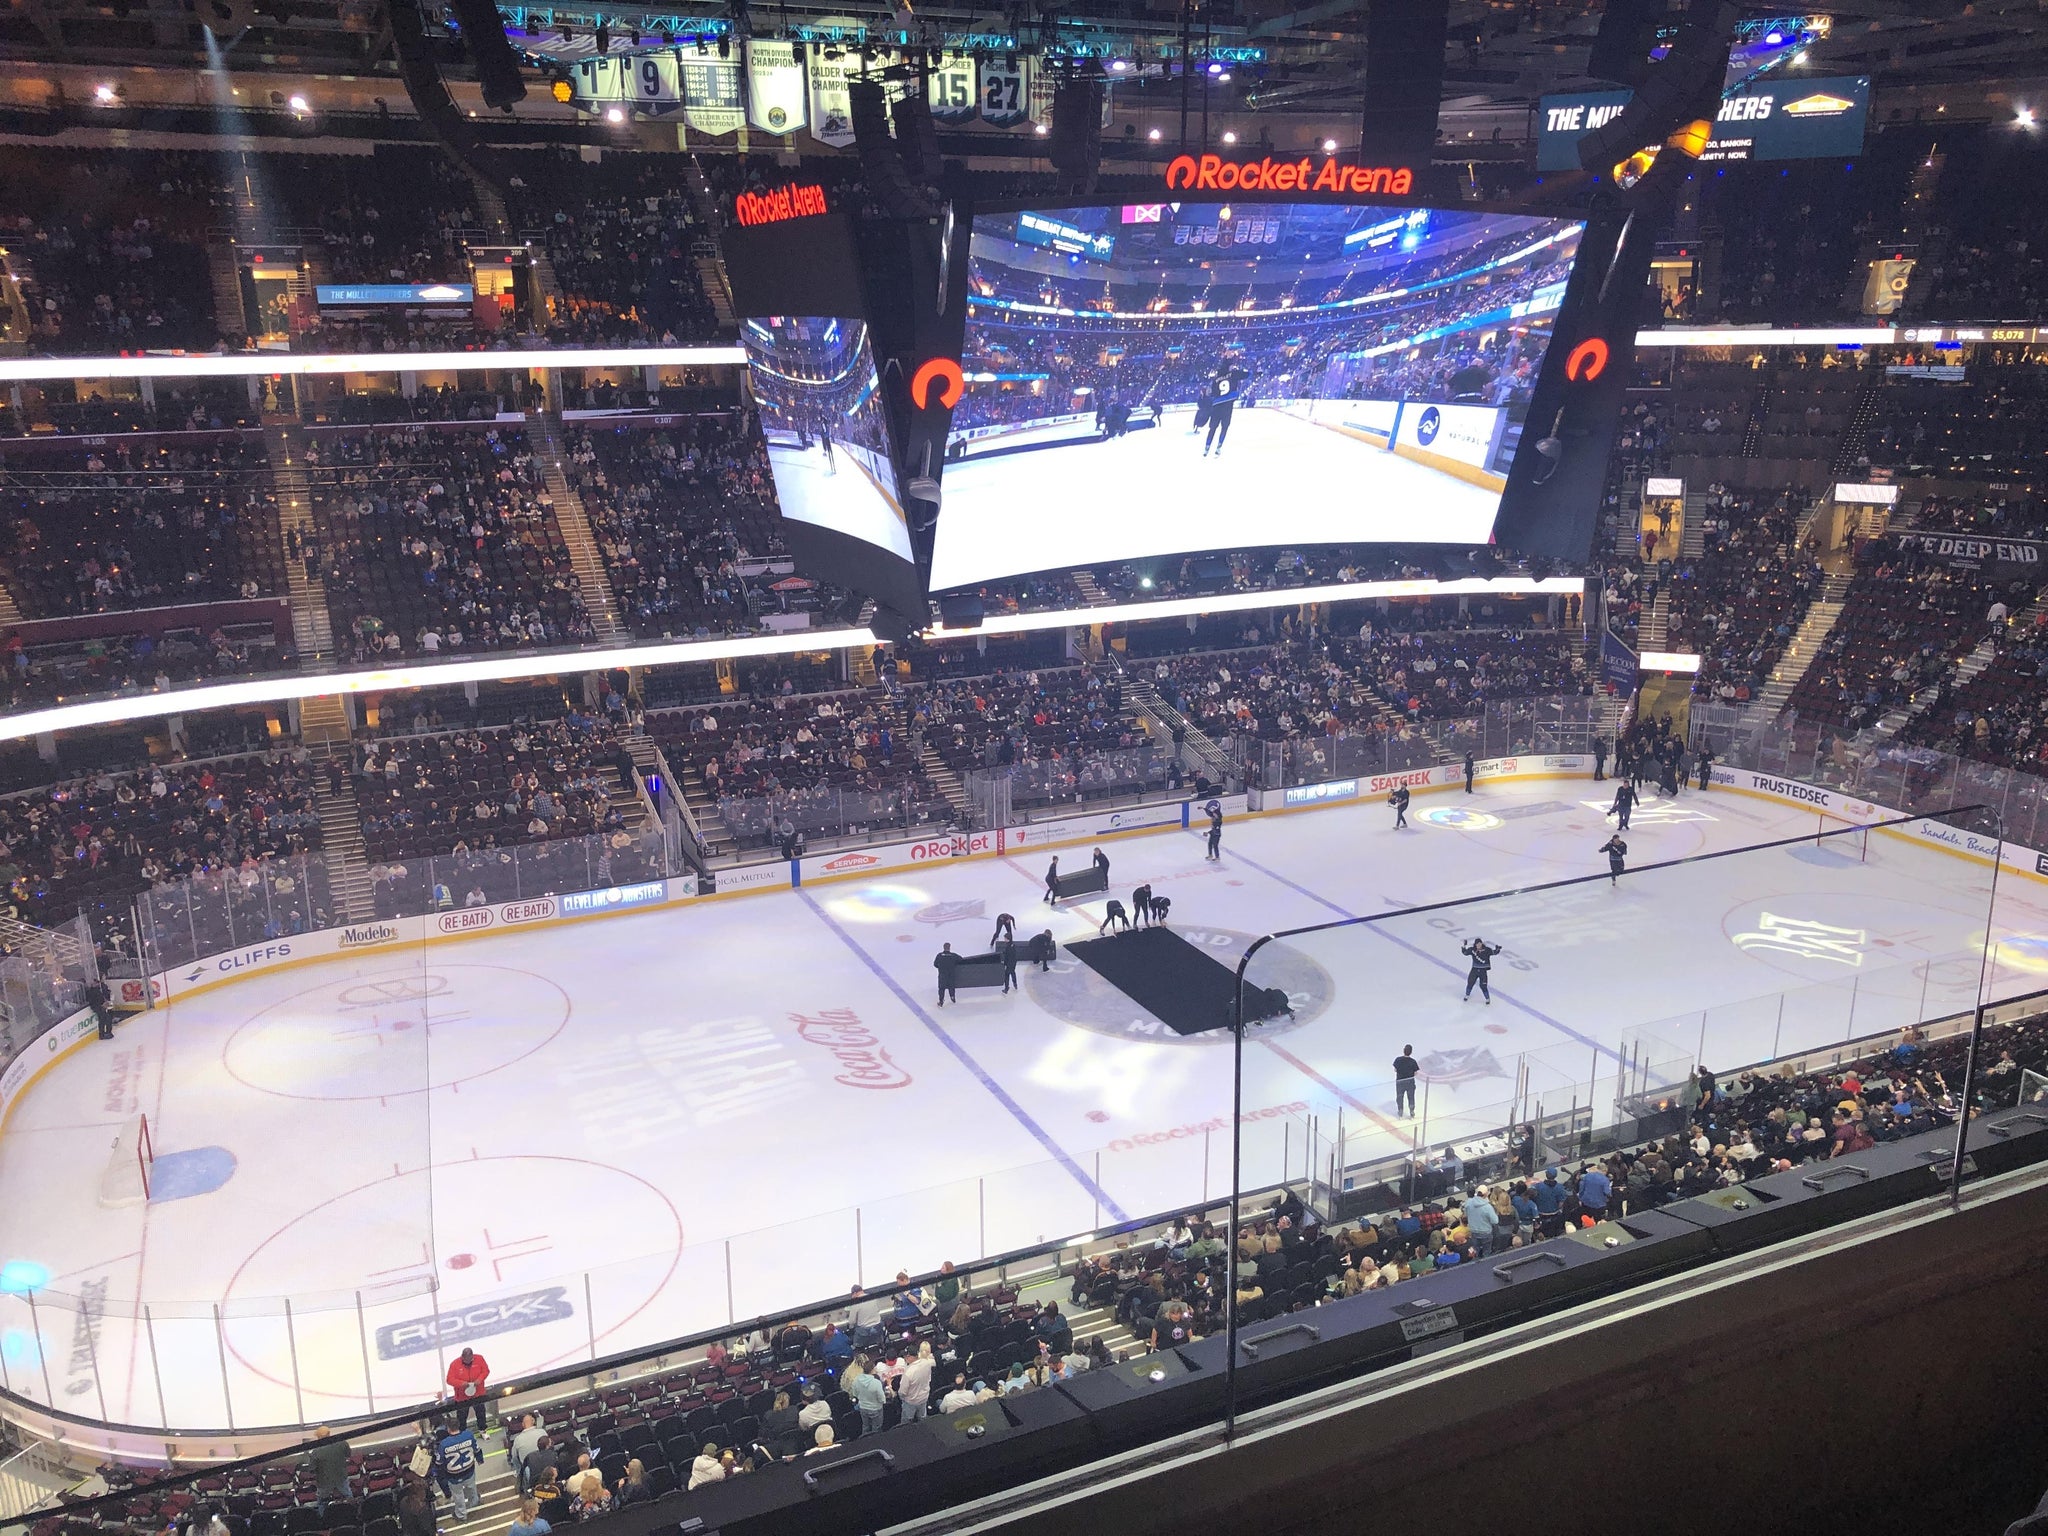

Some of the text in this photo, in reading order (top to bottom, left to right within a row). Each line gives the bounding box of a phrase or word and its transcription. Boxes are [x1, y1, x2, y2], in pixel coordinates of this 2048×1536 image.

[772, 50, 792, 58] DIVISIO
[642, 61, 660, 96] 9
[810, 66, 840, 78] CALDER
[937, 73, 968, 106] 15
[987, 76, 1020, 110] 27
[1547, 107, 1582, 131] THE
[1720, 139, 1752, 148] BANKING
[1728, 152, 1747, 160] NOW,
[1196, 154, 1413, 195] Rocket Arena
[746, 182, 827, 225] Rocket Arena
[331, 291, 343, 299] THE
[1992, 330, 2025, 340] $5,078
[1219, 380, 1230, 395] 9
[1897, 535, 2038, 563] TE DEEP END
[1481, 762, 1499, 772] mart
[1371, 770, 1431, 793] SEATGEEK
[1752, 776, 1830, 806] TRUSTEDSEC
[928, 835, 988, 858] Rocket
[833, 857, 869, 869] SERVPRO
[741, 871, 776, 884] MUTUAL
[345, 926, 391, 943] Modelo
[218, 943, 291, 971] CLIFFS
[445, 1446, 475, 1475] 23
